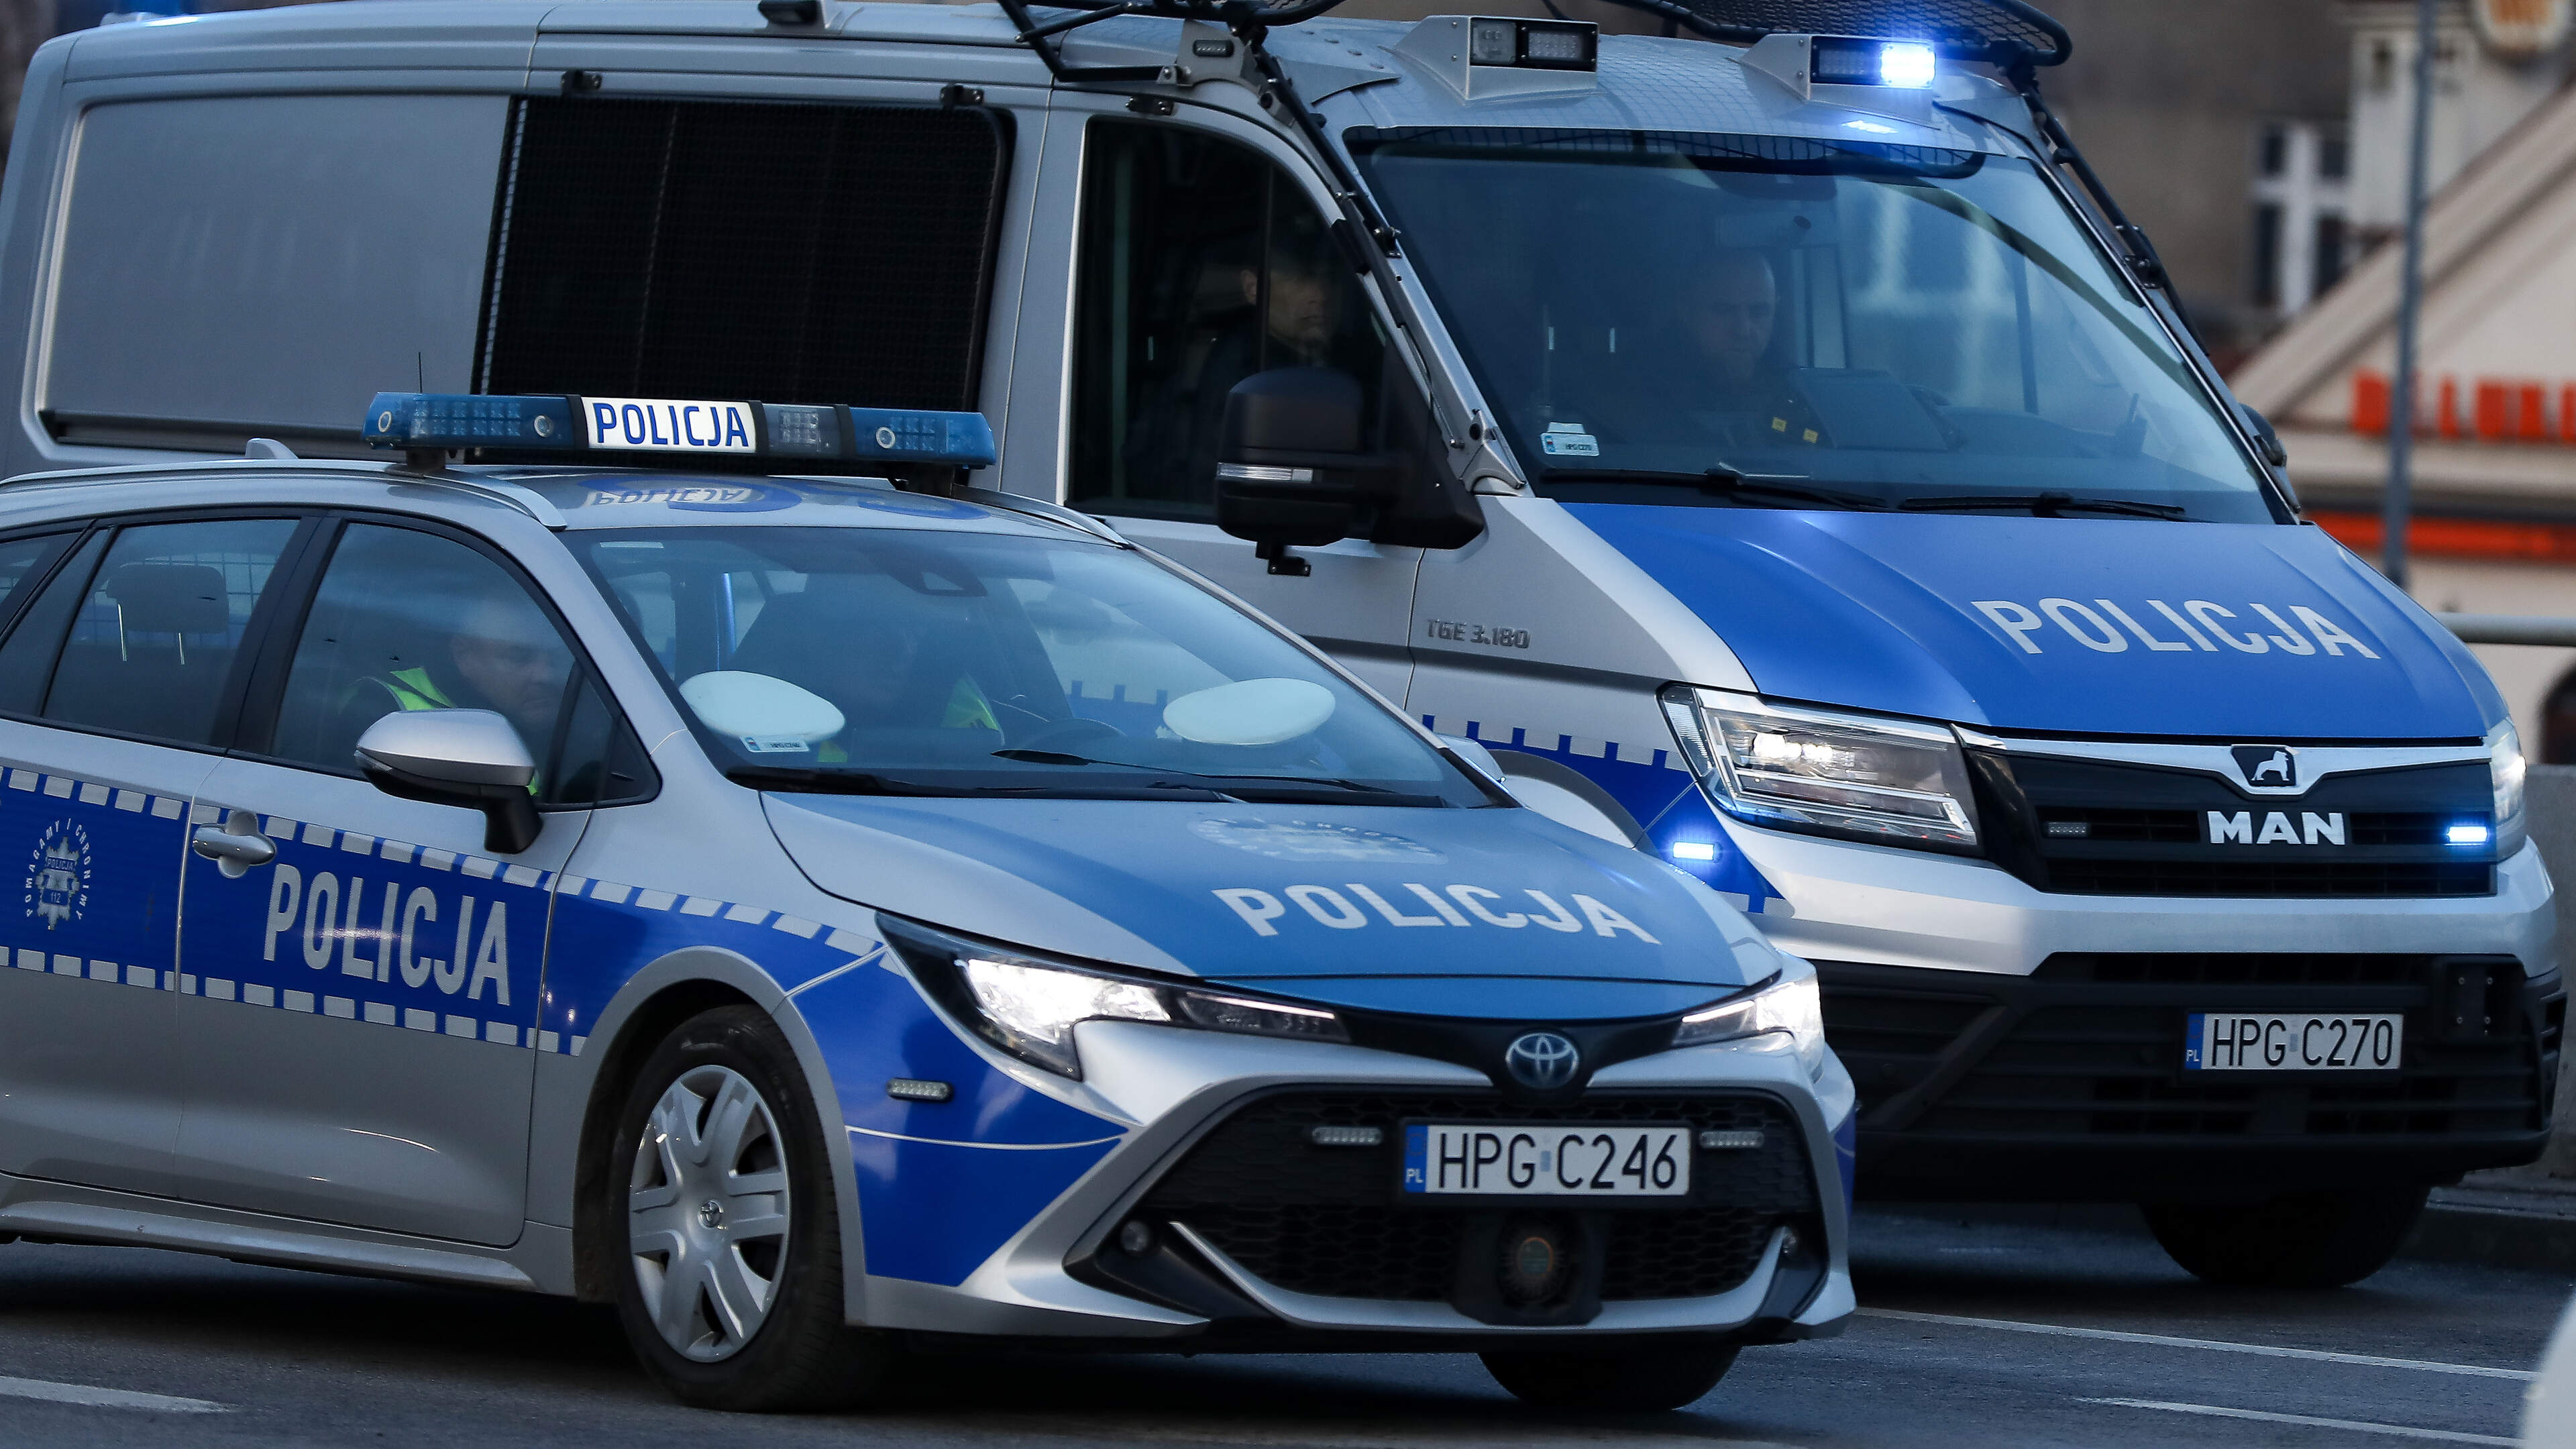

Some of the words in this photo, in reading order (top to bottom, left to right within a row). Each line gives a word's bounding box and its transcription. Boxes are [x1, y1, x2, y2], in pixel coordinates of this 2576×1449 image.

[592, 402, 749, 447] POLICJA
[1428, 619, 1466, 641] TGE
[1470, 625, 1530, 649] 3.180
[1970, 598, 2381, 659] POLICJA
[2207, 811, 2346, 845] MAN
[24, 820, 60, 917] POMAGAMY
[66, 818, 71, 830] I
[75, 824, 91, 920] CHRONIMY
[47, 858, 74, 871] POLICJA
[50, 892, 61, 903] 112
[1212, 883, 1662, 945] POLICJA
[264, 864, 510, 1006] POLICJA
[2186, 1049, 2200, 1062] PL
[2212, 1018, 2286, 1067] HPG
[2302, 1018, 2394, 1067] C270
[1406, 1169, 1423, 1183] PL
[1438, 1133, 1536, 1189] HPG
[1557, 1134, 1678, 1189] C246
